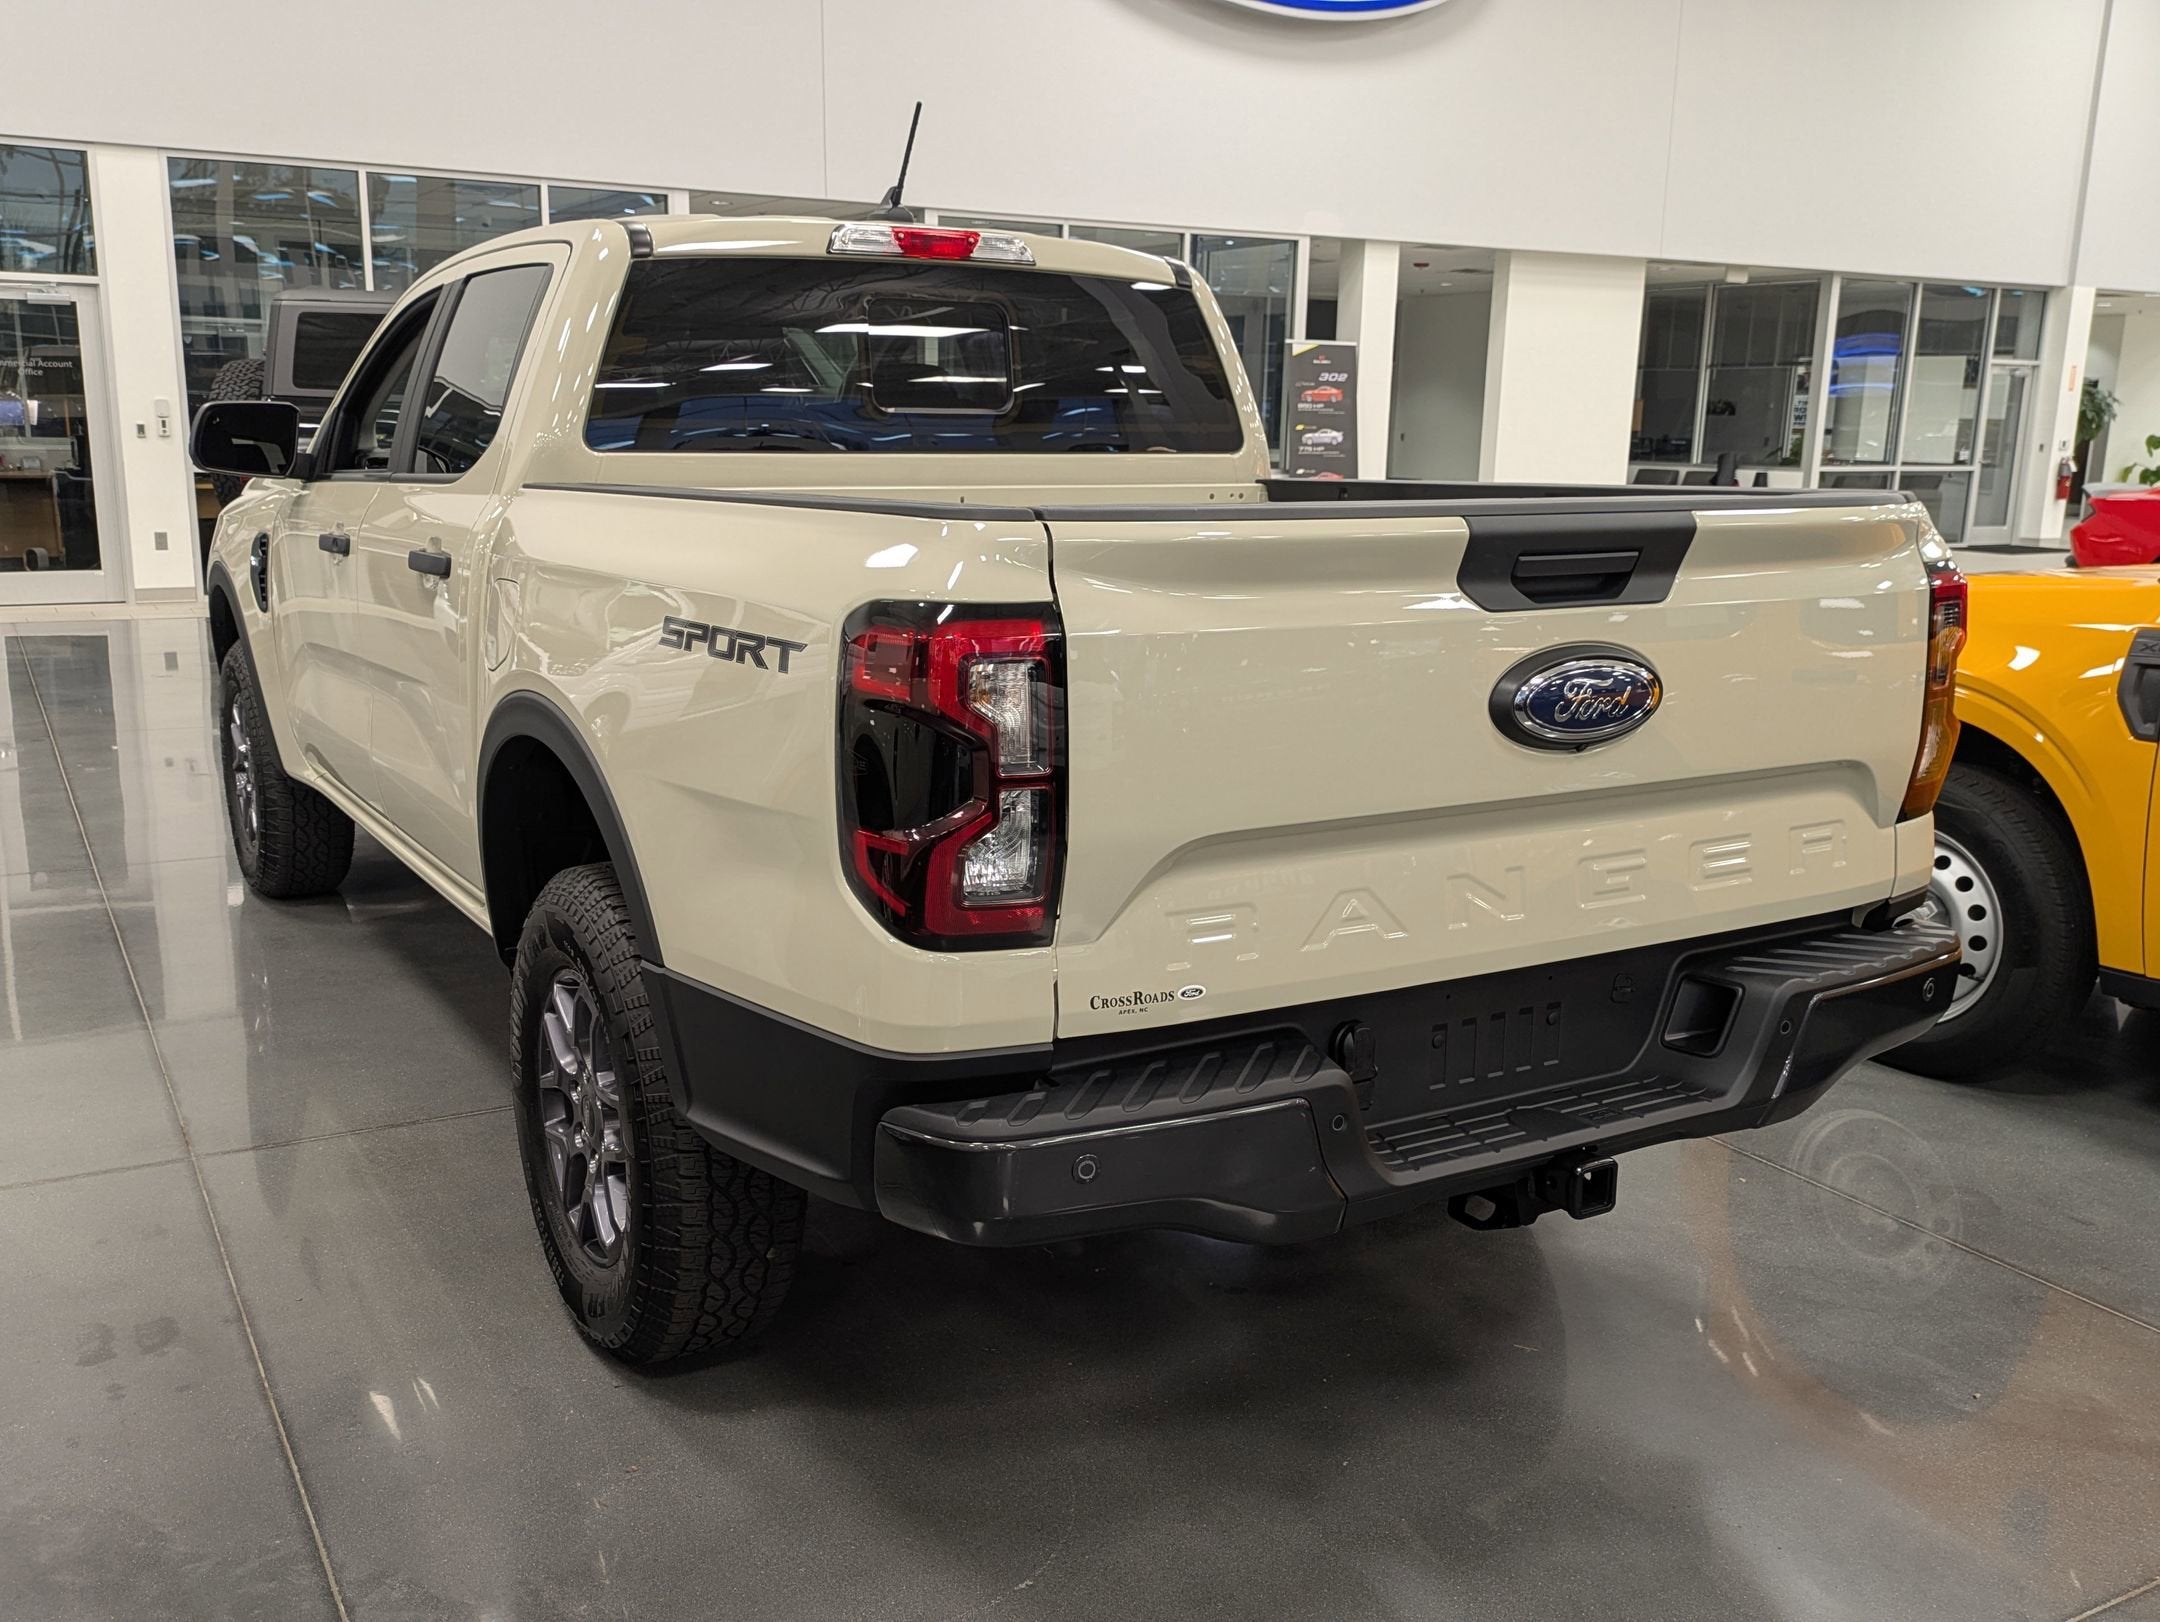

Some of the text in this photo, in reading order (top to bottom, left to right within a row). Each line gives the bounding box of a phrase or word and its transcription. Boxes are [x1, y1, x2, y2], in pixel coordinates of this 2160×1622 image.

[18, 367, 44, 376] Office
[38, 360, 73, 368] Account
[1319, 373, 1348, 382] 302
[658, 615, 809, 674] SPORT
[1554, 678, 1632, 723] Ford
[1165, 819, 1847, 972] RANGER
